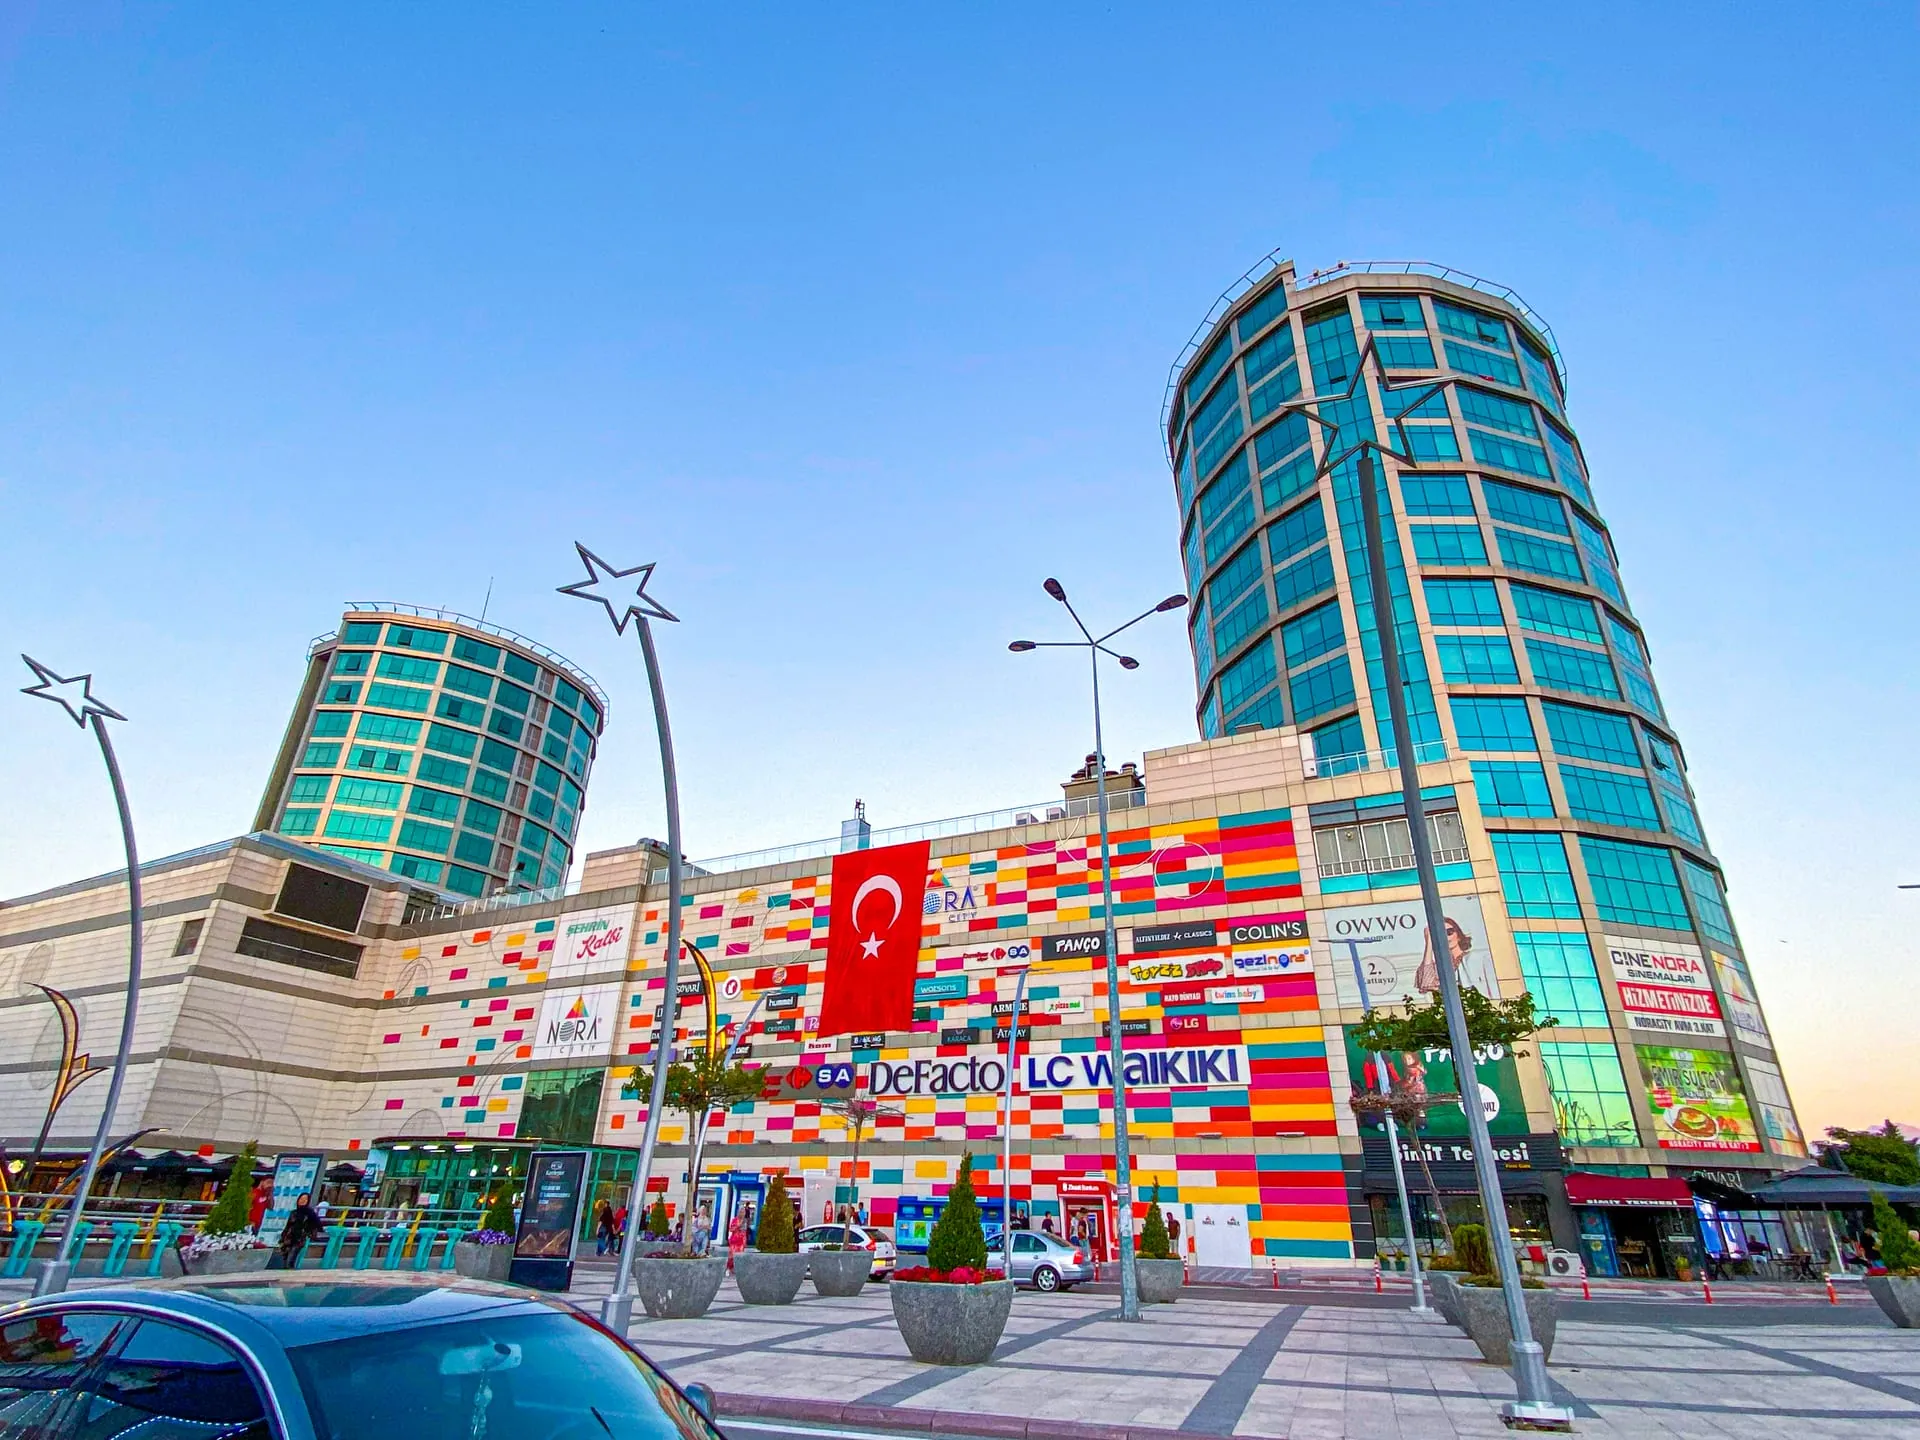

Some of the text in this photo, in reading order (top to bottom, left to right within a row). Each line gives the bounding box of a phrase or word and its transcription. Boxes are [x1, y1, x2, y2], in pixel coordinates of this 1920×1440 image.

[1235, 921, 1302, 941] COLIN'S
[1336, 914, 1416, 935] OWWO
[577, 926, 623, 959] Kalbi
[1183, 930, 1213, 939] CLASSICS
[1055, 937, 1101, 953] PANÇO
[1367, 962, 1382, 975] 2.
[920, 984, 957, 993] watsons
[1365, 977, 1394, 985] attayız
[1184, 1018, 1200, 1028] LG
[868, 1056, 1005, 1095] DeFacto
[1028, 1056, 1073, 1087] LC
